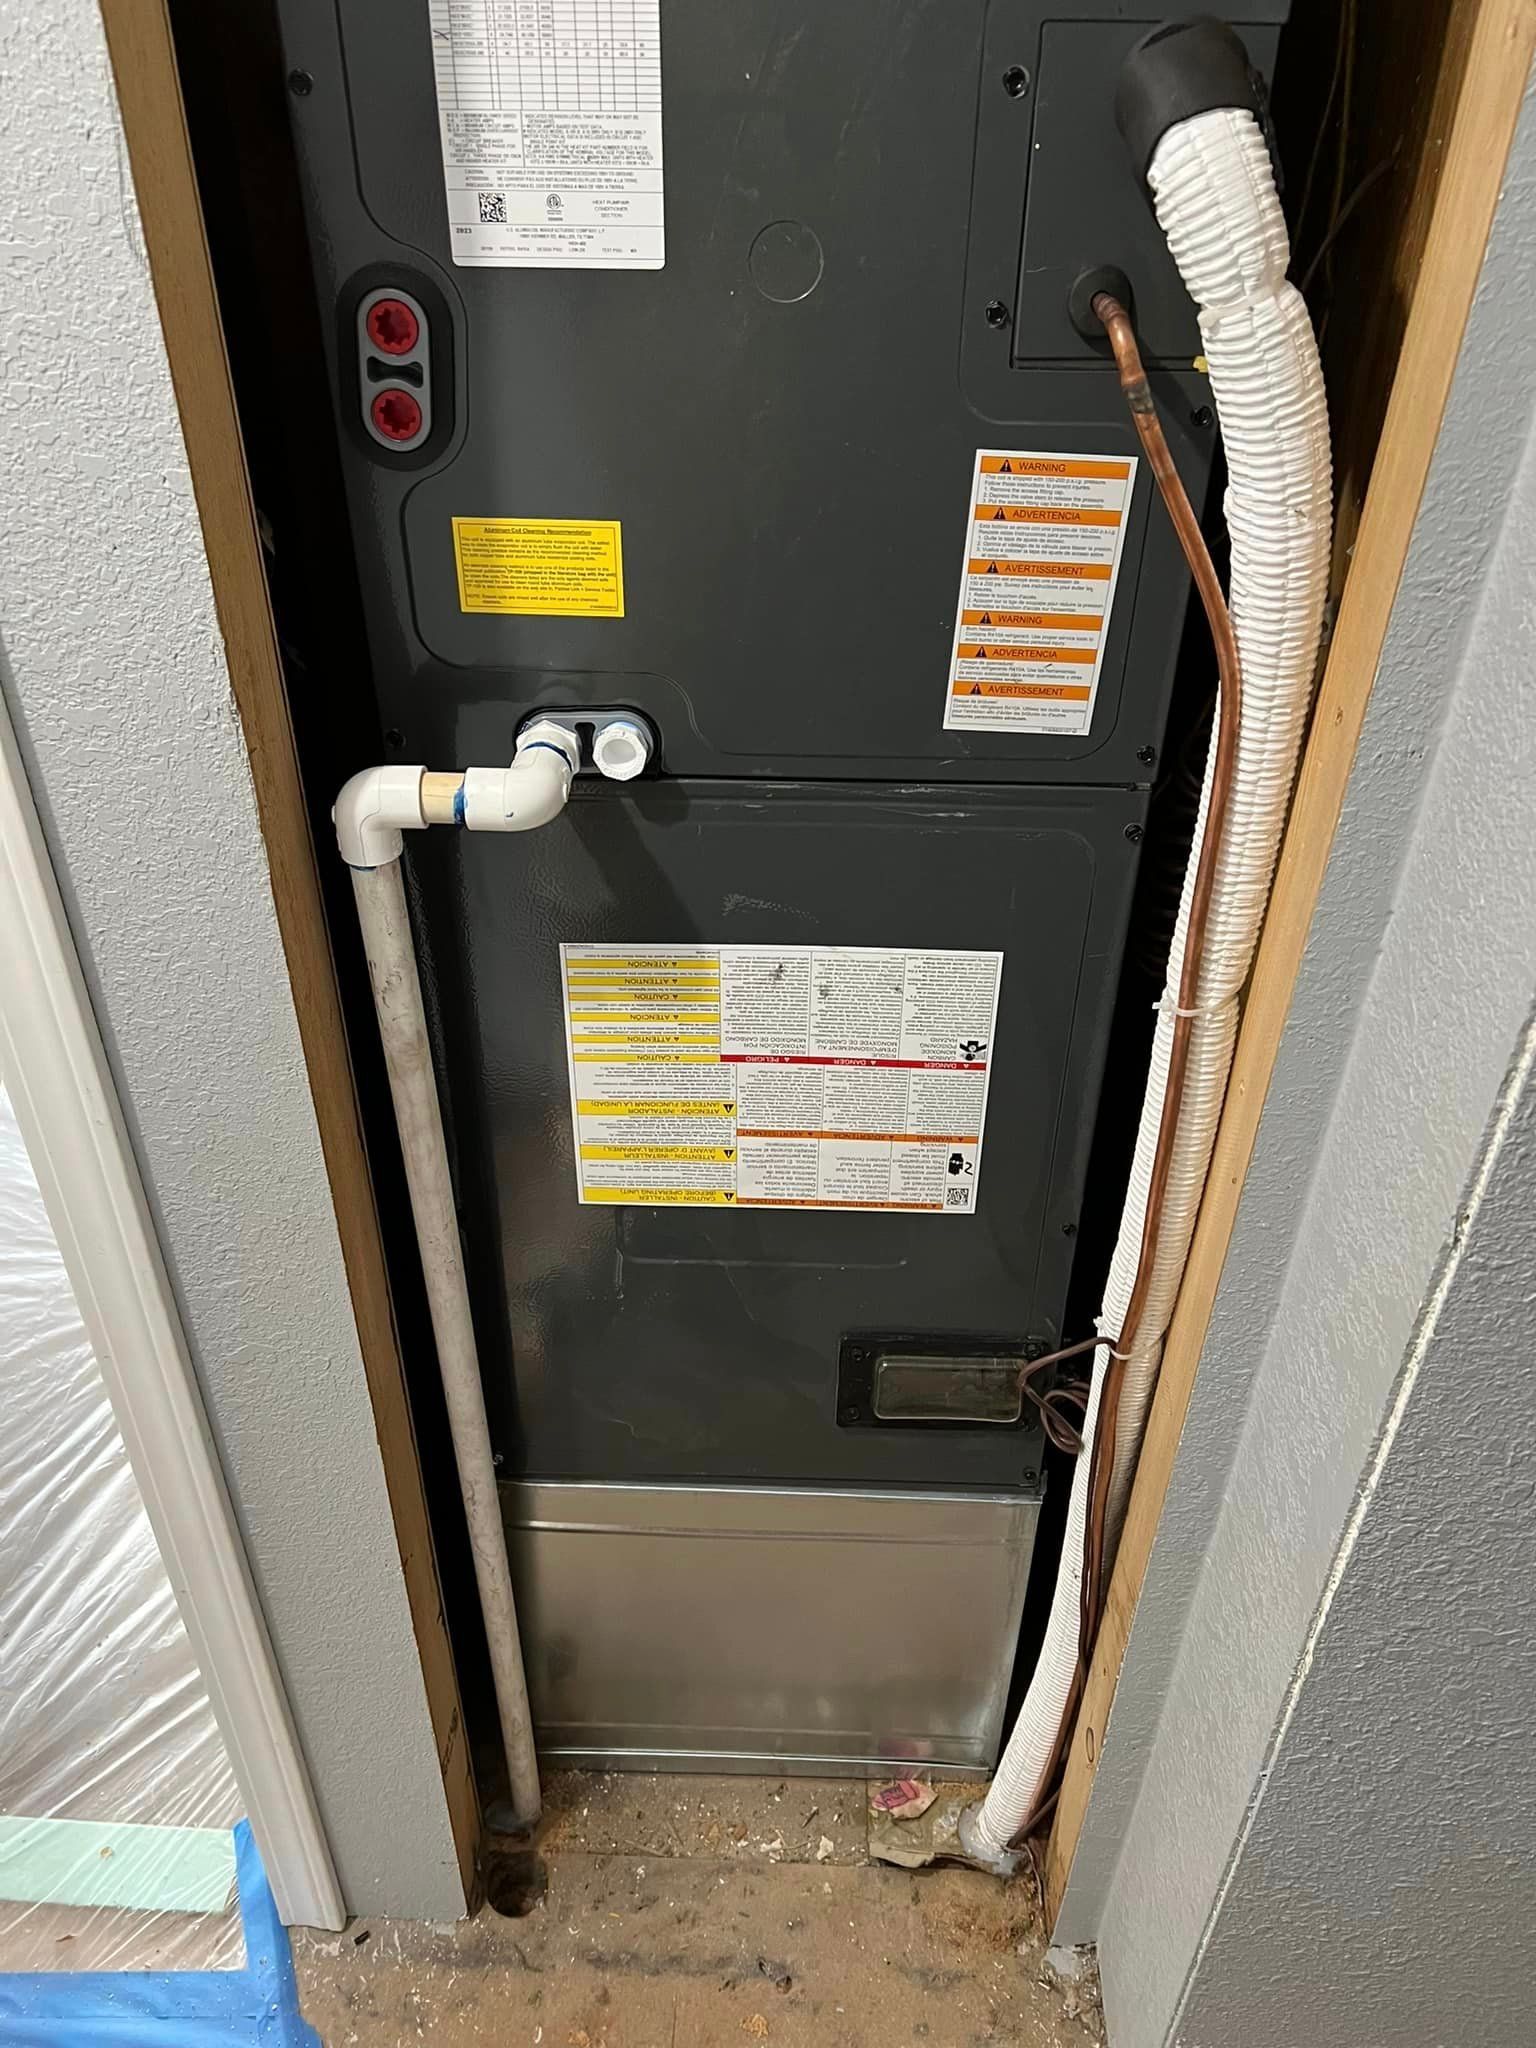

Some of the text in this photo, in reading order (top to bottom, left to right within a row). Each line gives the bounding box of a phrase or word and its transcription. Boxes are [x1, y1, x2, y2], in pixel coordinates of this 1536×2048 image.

[1019, 462, 1066, 472] WARNING
[1012, 510, 1081, 520] ADVERTENCIA
[1005, 565, 1084, 575] AVERTISSEMENT
[998, 614, 1042, 624] WARNING
[992, 648, 1057, 658] ADVERTENCIA
[988, 685, 1064, 696] AVERTISSEMENT
